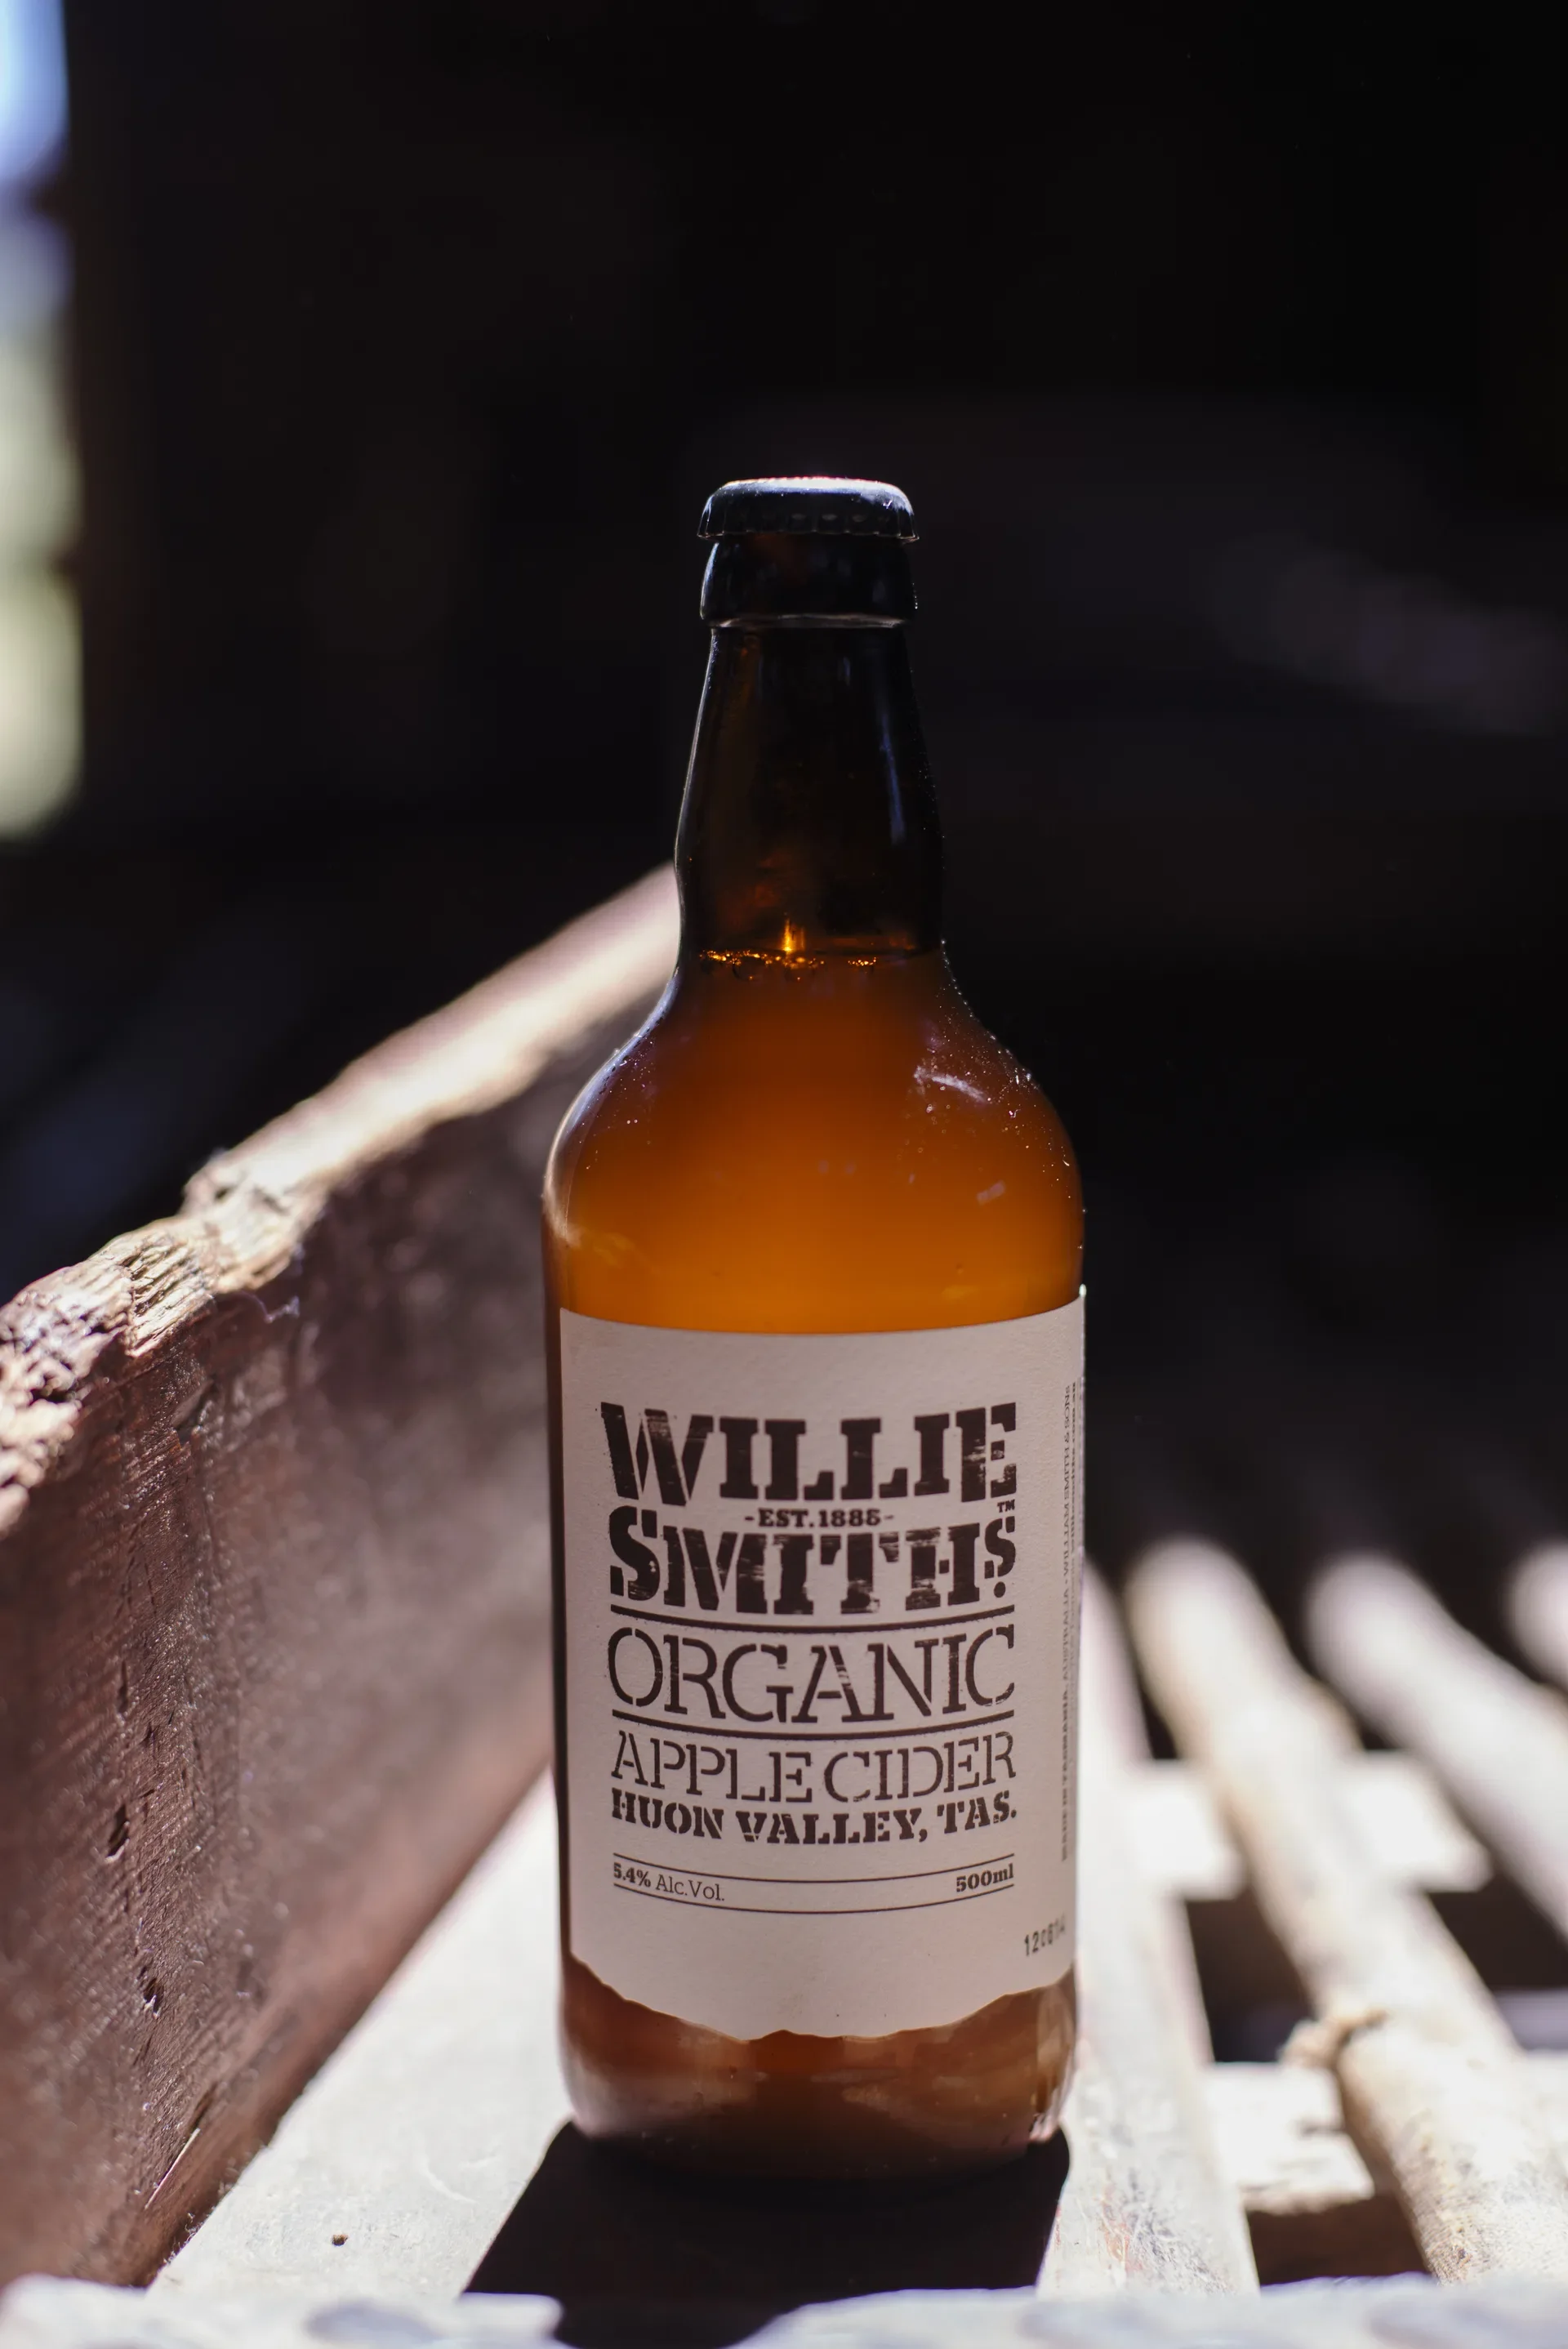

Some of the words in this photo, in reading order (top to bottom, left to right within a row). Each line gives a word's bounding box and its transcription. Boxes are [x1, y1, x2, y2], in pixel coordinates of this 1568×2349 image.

[601, 1402, 1016, 1506] WILLIE
[608, 1624, 1015, 1723] ORGANIC
[611, 1730, 813, 1803] APPLE
[823, 1732, 1016, 1803] CIDER
[612, 1786, 724, 1840] HUON
[736, 1807, 929, 1845] VALLEY,
[937, 1790, 1017, 1834] TAS.
[612, 1862, 652, 1888] 5.4%
[956, 1863, 1014, 1893] 500ml
